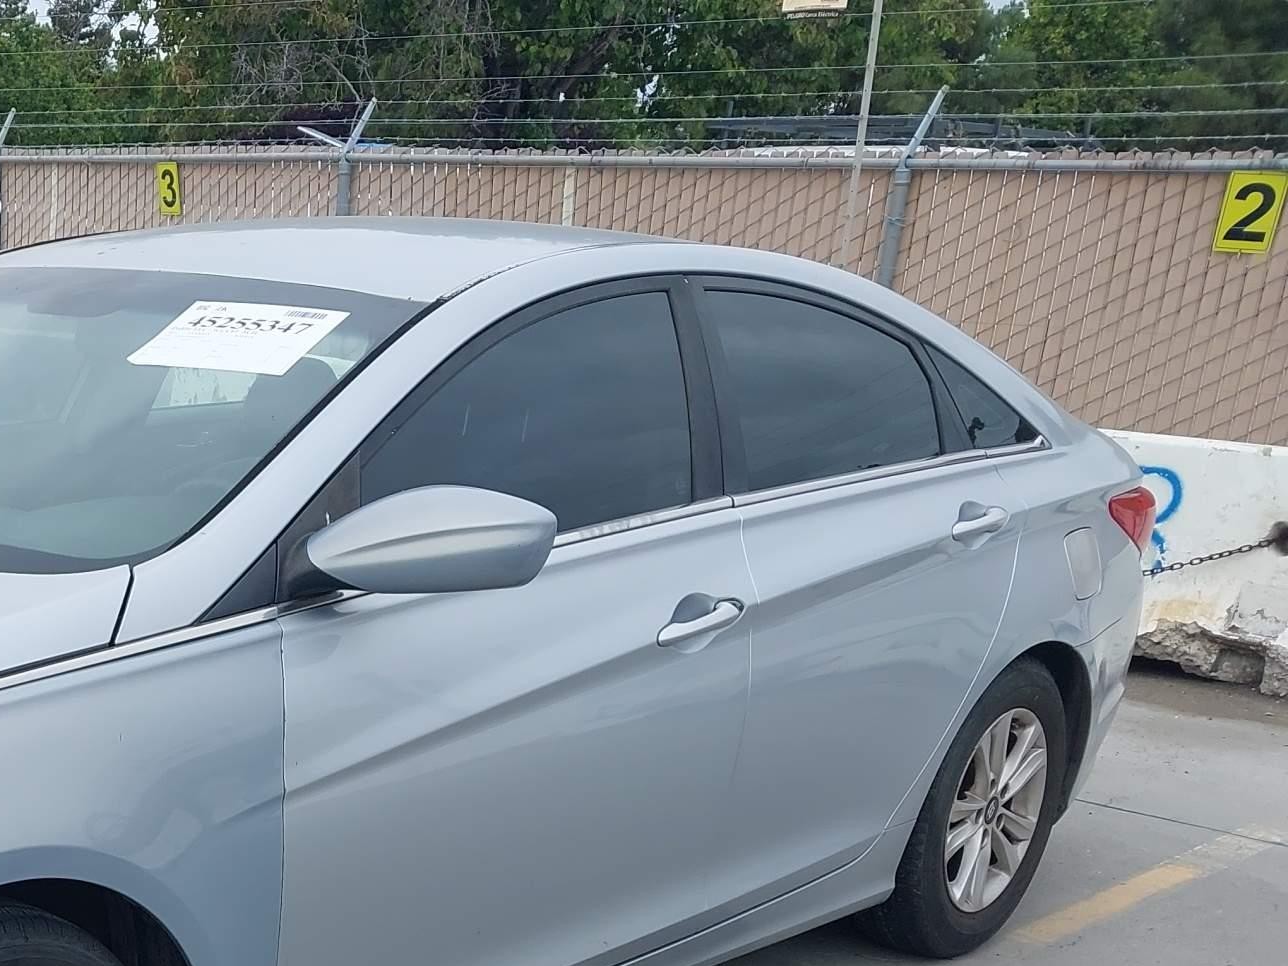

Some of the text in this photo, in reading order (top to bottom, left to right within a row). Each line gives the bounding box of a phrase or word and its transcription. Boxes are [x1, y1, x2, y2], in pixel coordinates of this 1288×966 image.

[161, 168, 177, 208] 3
[1222, 182, 1277, 243] 2
[187, 315, 315, 335] 45255347
